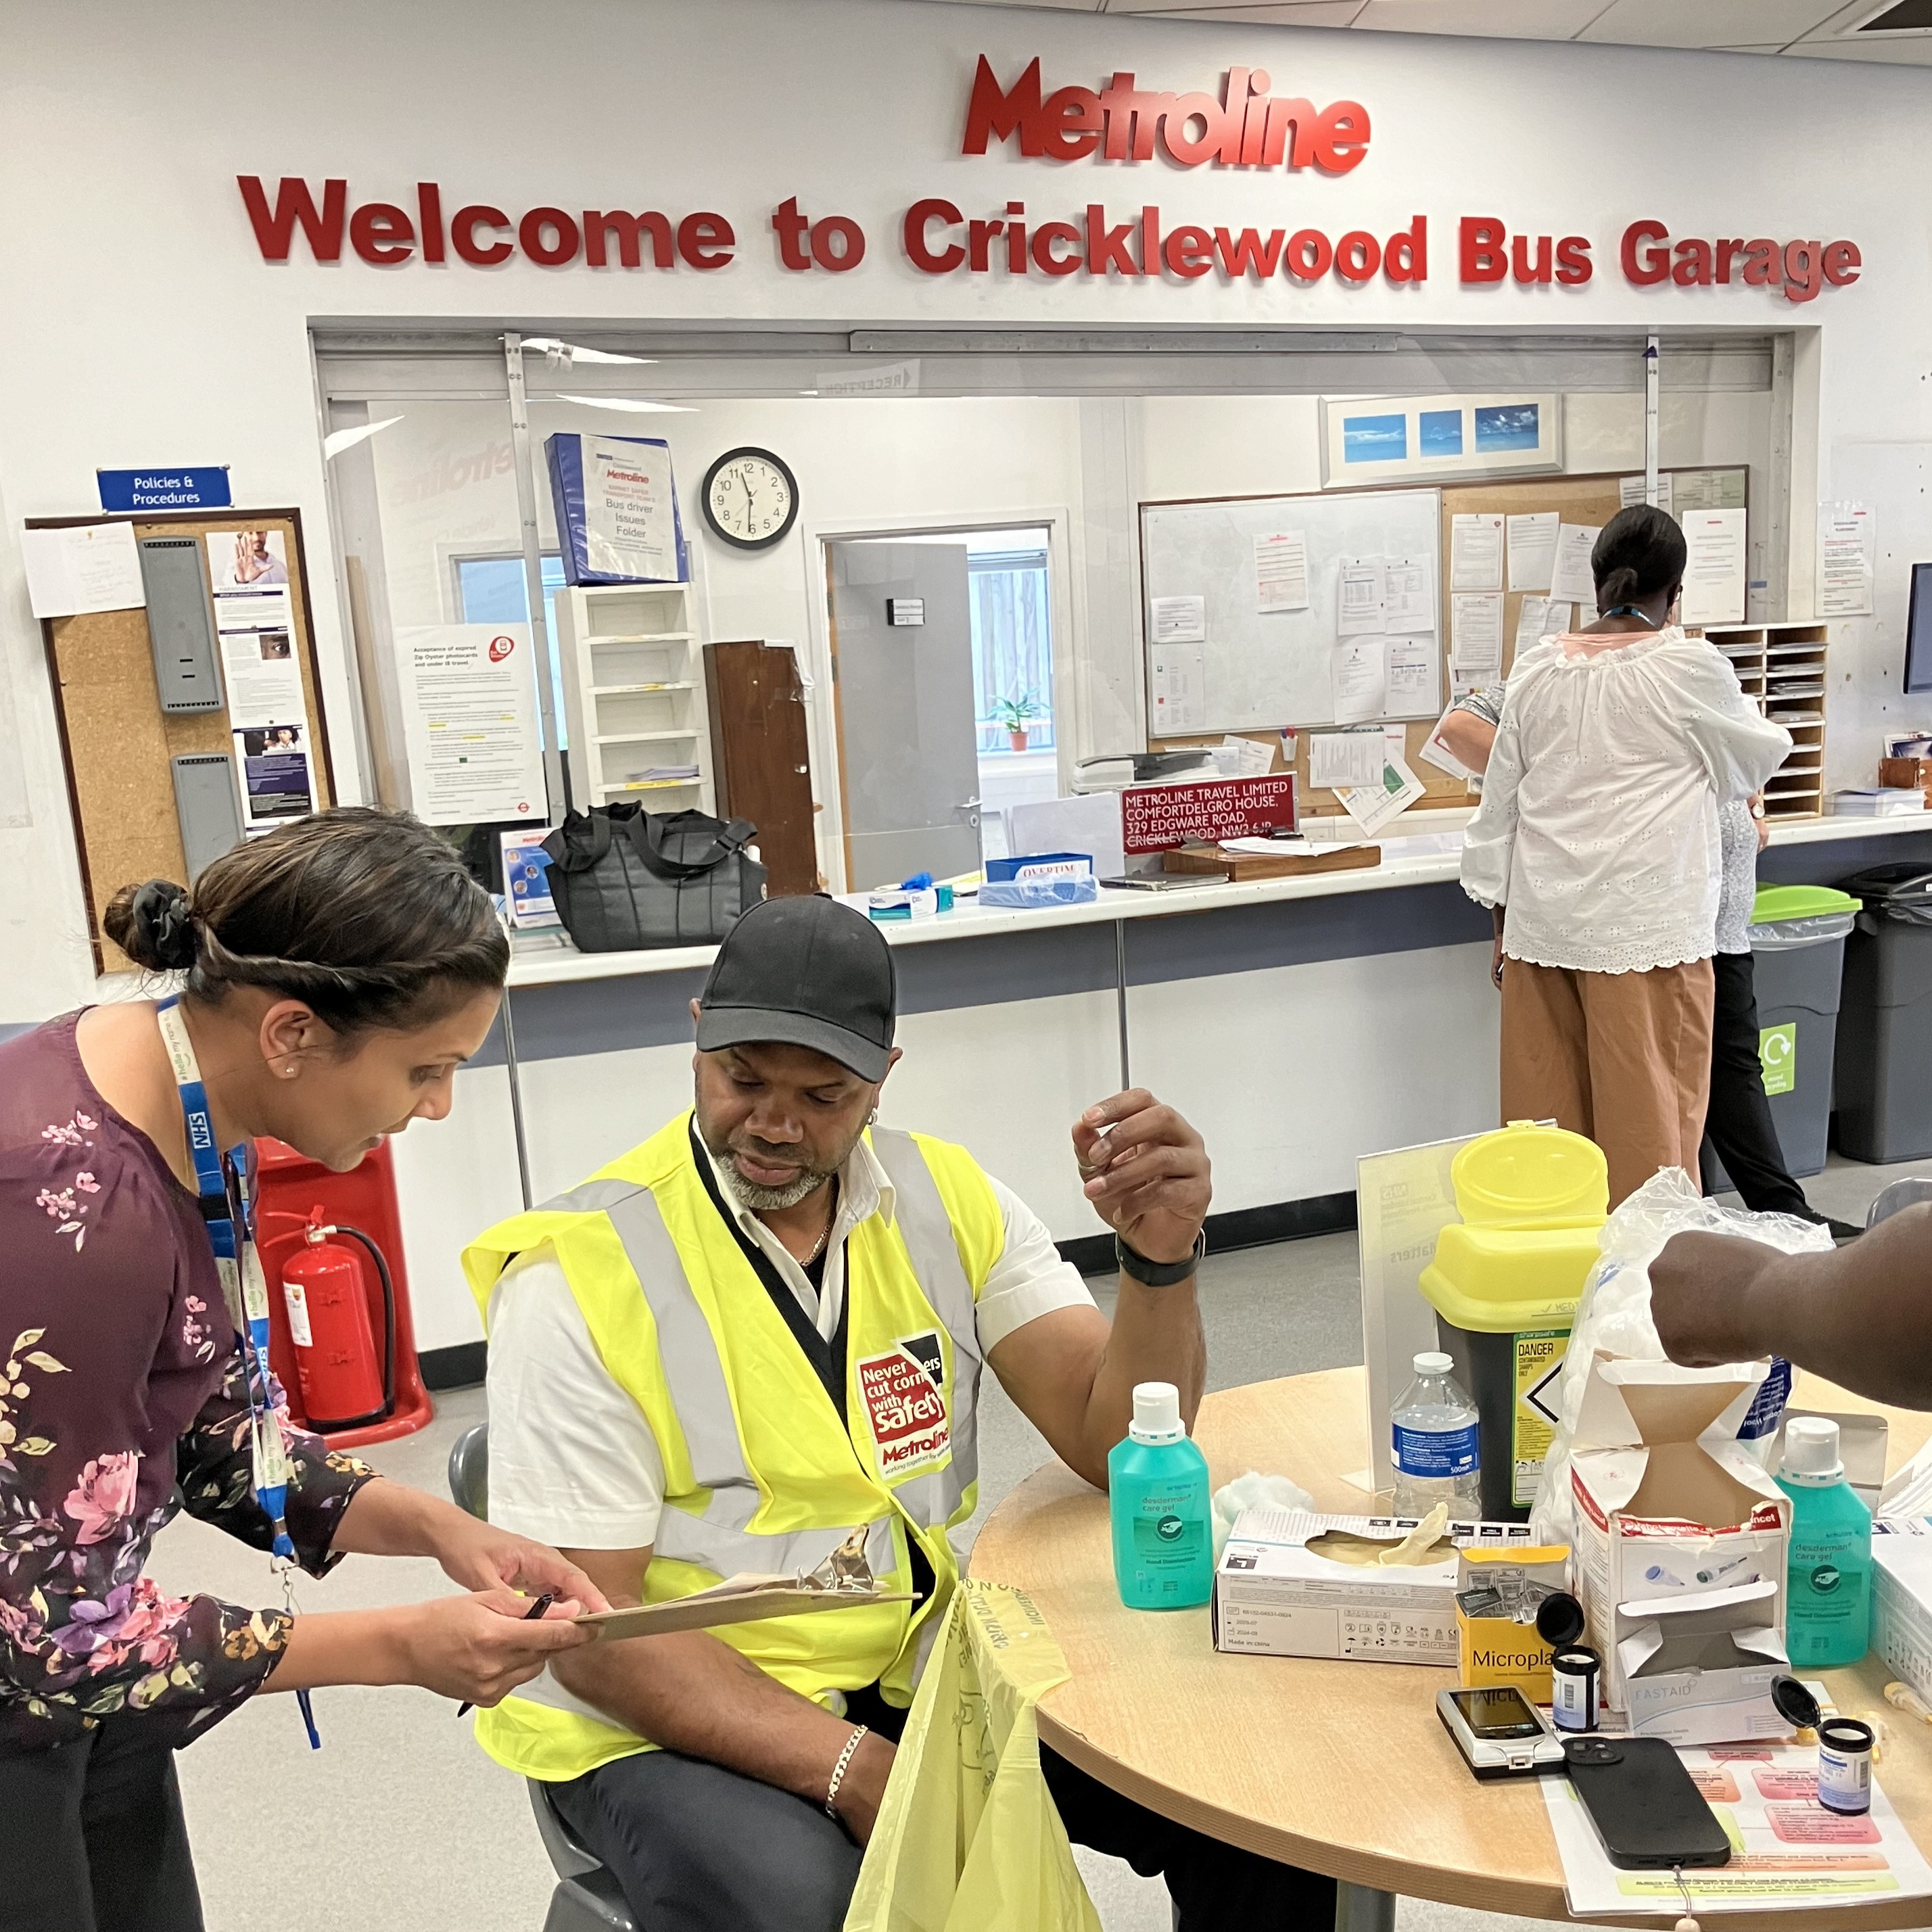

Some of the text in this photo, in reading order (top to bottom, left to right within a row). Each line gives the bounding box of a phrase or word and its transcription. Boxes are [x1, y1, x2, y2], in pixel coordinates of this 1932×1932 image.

[962, 54, 1371, 172] Metroline
[237, 175, 1861, 302] Welcome to Cricklewood Bus Garage
[729, 469, 738, 479] 11
[744, 463, 754, 473] 12
[761, 467, 765, 476] 1
[134, 476, 194, 489] Policies &
[607, 469, 649, 484] Metroline
[771, 477, 778, 487] 2
[720, 480, 731, 491] 10
[133, 492, 200, 504] Procedures
[717, 495, 724, 506] 9
[777, 492, 784, 502] 3
[606, 498, 653, 513] Bus driver
[773, 507, 780, 517] 4
[615, 513, 646, 525] Issues
[724, 510, 730, 521] 8
[735, 521, 742, 531] 7
[763, 519, 770, 529] 5
[616, 525, 646, 538] Folder
[1125, 781, 1288, 808] METROLINE TRAVEL LIMITED
[1126, 800, 1233, 822] COMFORTDELGRO
[1127, 822, 1148, 834] 329
[1151, 816, 1210, 832] EDGWARE
[1221, 823, 1249, 837] NW2
[1252, 822, 1271, 834] 6JP
[190, 1114, 210, 1147] NHS
[1519, 1343, 1554, 1357] DANGER
[863, 1361, 907, 1384] Never
[867, 1381, 891, 1398] cut
[872, 1394, 902, 1412] with
[875, 1391, 943, 1433] safety
[883, 1428, 949, 1465] Metroline
[1162, 1504, 1175, 1513] gel
[1818, 1553, 1832, 1561] gel
[1473, 1649, 1554, 1670] Micropla
